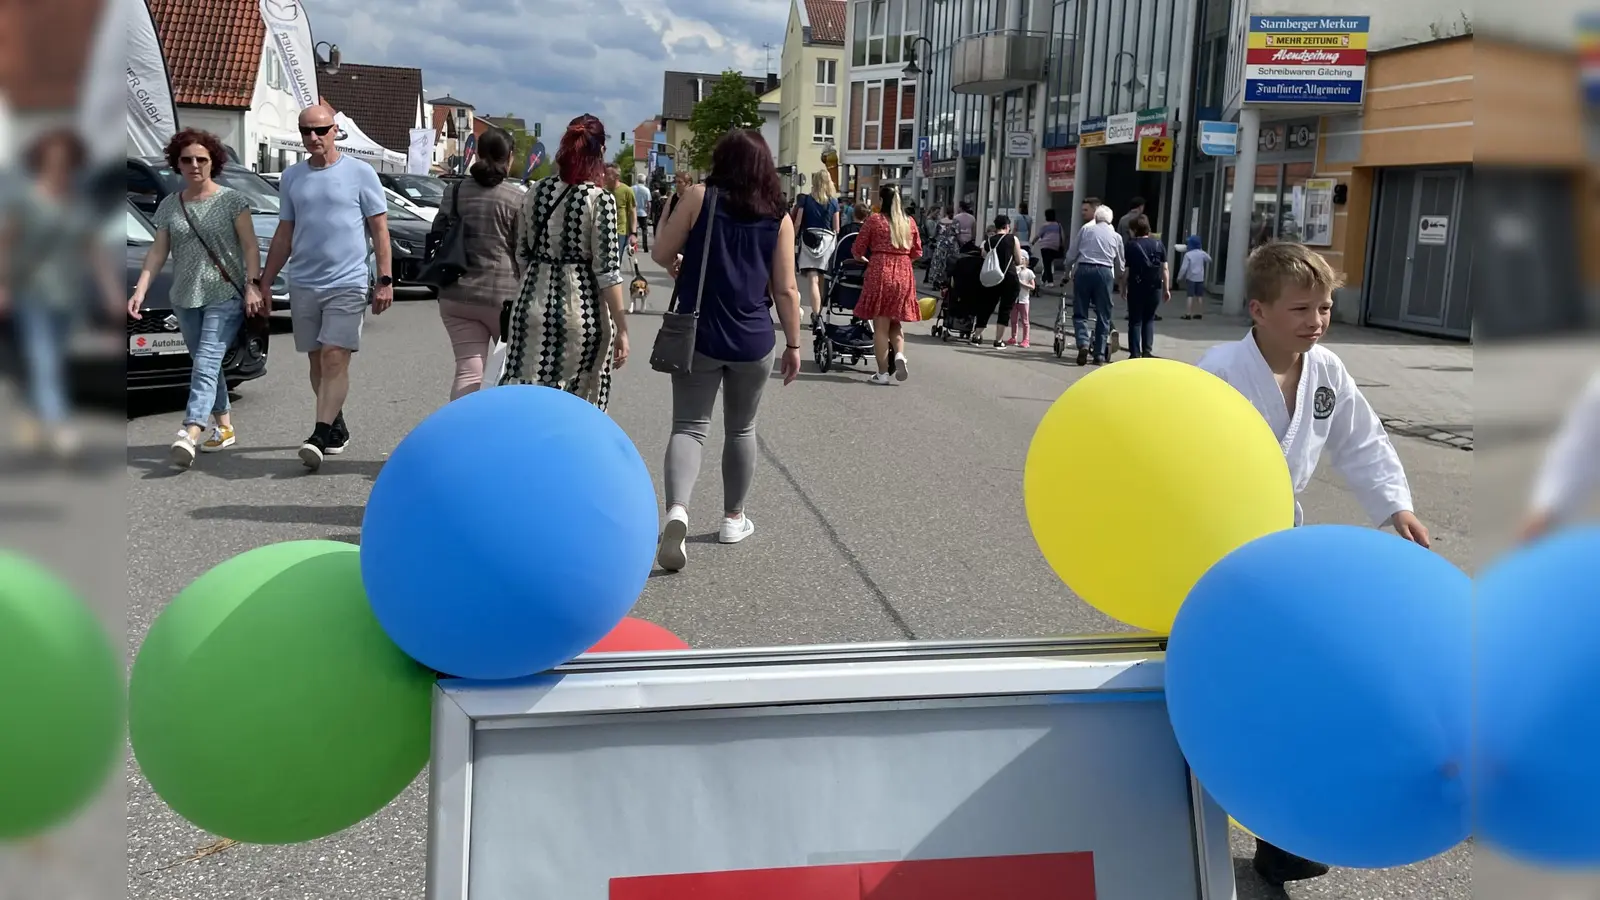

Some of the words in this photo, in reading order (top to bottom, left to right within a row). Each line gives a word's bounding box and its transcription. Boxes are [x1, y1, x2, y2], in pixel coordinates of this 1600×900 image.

[1260, 18, 1318, 31] Starnberger
[1319, 18, 1358, 29] Merkur
[1276, 36, 1301, 44] MEHR
[1303, 36, 1338, 45] ZEITUNG
[1272, 49, 1340, 64] Abendzeitung
[1258, 67, 1315, 76] Schreibwaren
[1317, 67, 1352, 78] Gilching
[127, 67, 141, 88] ER
[136, 89, 162, 124] GMBH
[1256, 83, 1303, 96] Frankfurter
[1303, 83, 1351, 96] Allgemeine
[1109, 124, 1133, 140] Gilching
[920, 139, 927, 157] P
[1143, 155, 1169, 163] LOTTO
[152, 338, 186, 347] Autohau
